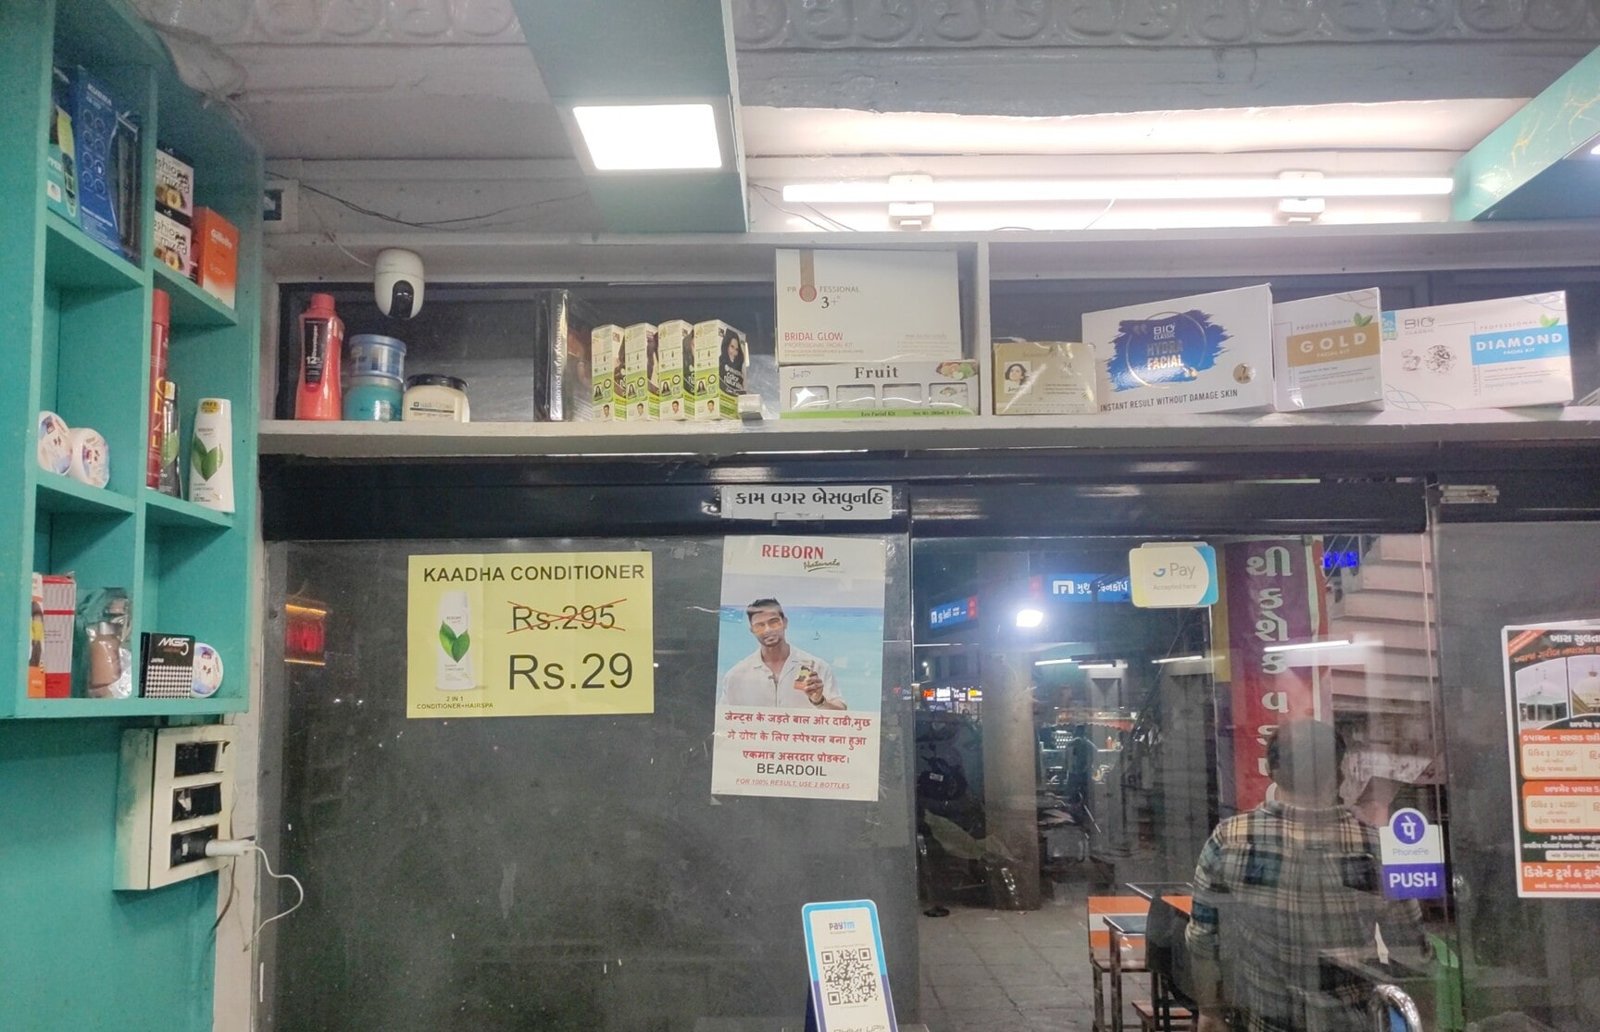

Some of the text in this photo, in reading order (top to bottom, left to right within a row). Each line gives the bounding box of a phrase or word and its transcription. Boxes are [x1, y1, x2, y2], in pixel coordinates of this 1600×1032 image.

[1153, 324, 1175, 334] BIO
[1404, 316, 1435, 330] BIO
[784, 332, 843, 341] BRIDAL GLOW
[1300, 332, 1367, 353] GOLD
[1475, 333, 1562, 352] DIAMOND
[1147, 355, 1184, 370] FACIAL
[855, 367, 899, 379] Fruit
[1100, 389, 1238, 412] INSTANT RESULT WITHOUT DAMAGE SKIN
[736, 492, 764, 505] કામ
[771, 492, 806, 505] વગર
[762, 544, 824, 560] REBORN
[424, 564, 645, 582] KAADHA CONDITIONER
[1169, 563, 1196, 579] Pay
[512, 604, 616, 631] Rs.295
[508, 652, 633, 690] Rs.29
[756, 712, 766, 721] के
[793, 715, 811, 724] बाल
[760, 731, 770, 740] के
[772, 731, 790, 741] लिए
[829, 736, 847, 744] बना
[849, 736, 867, 750] हुआ
[778, 752, 815, 761] असरदार
[757, 763, 827, 776] BEARDOIL
[1389, 872, 1437, 888] PUSH
